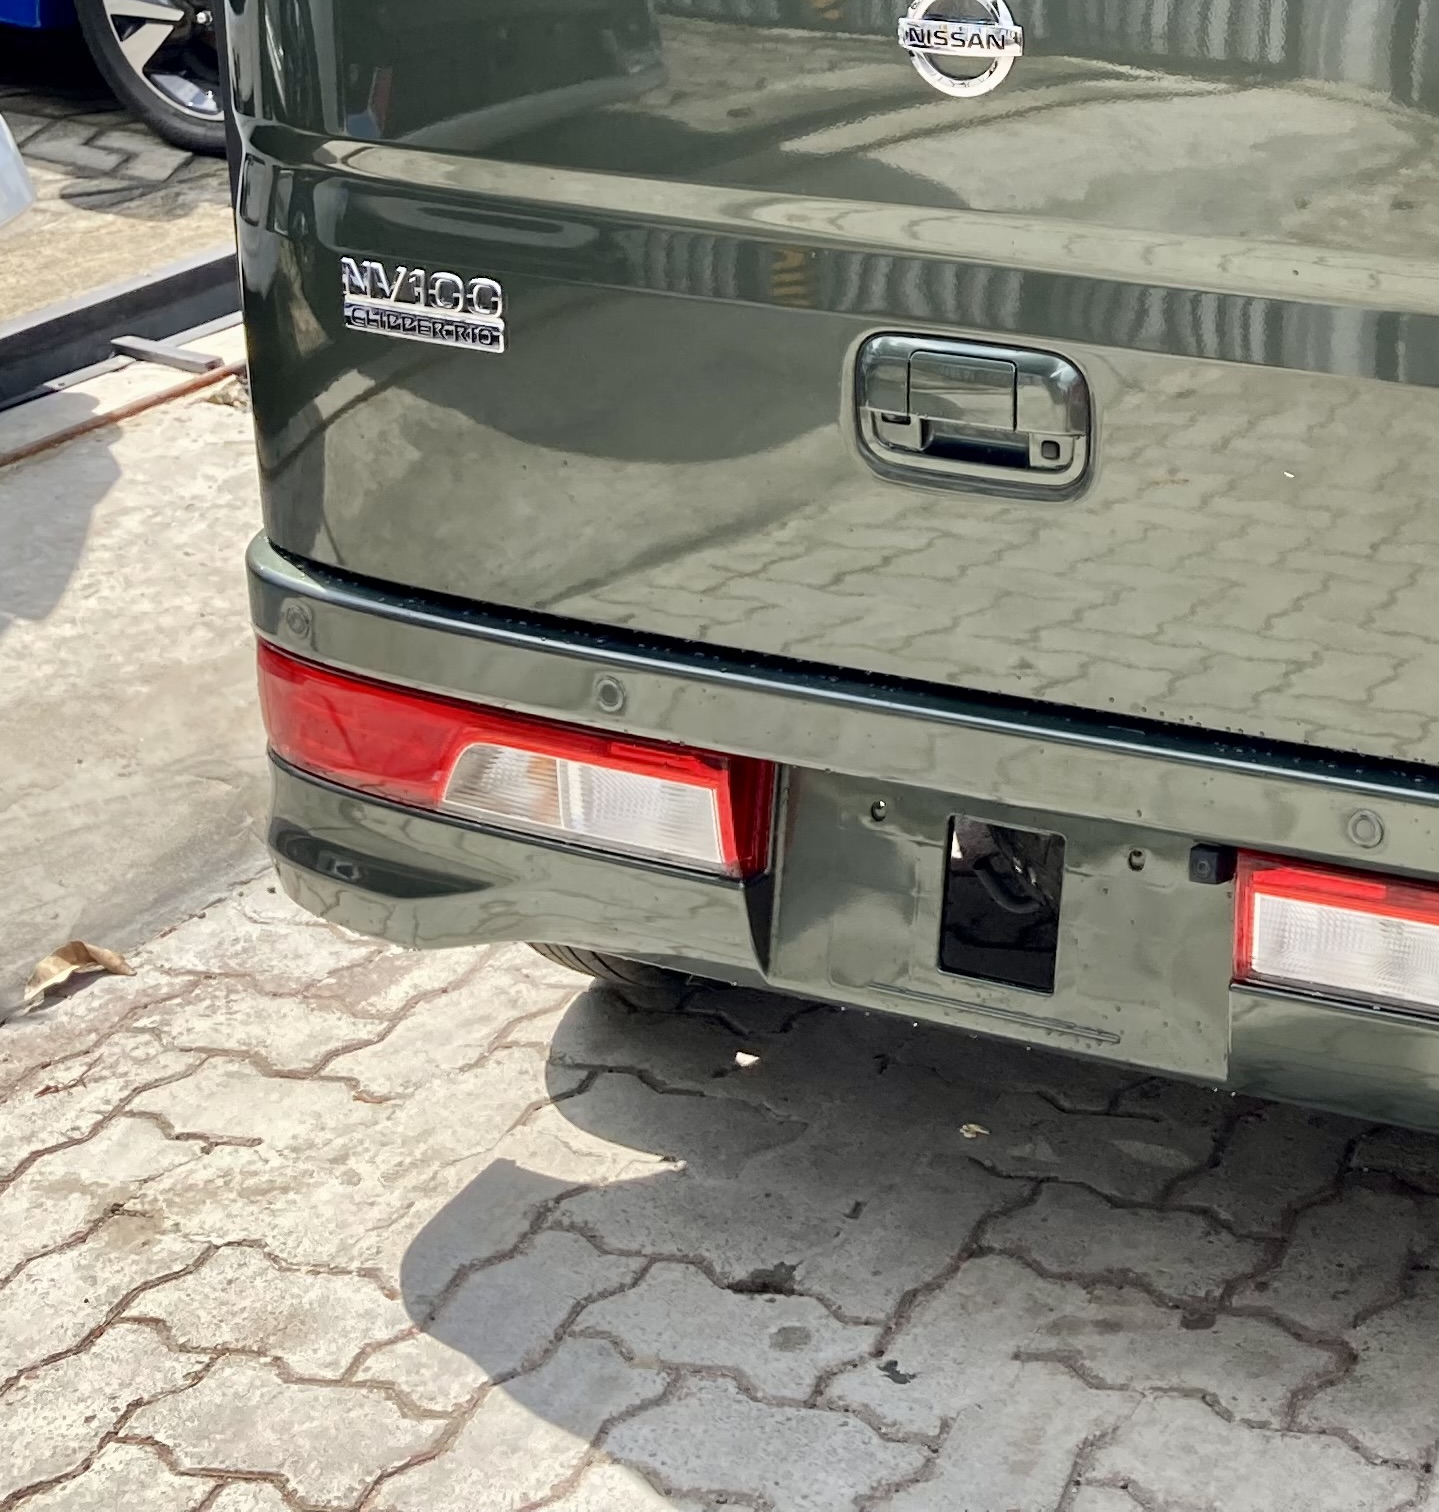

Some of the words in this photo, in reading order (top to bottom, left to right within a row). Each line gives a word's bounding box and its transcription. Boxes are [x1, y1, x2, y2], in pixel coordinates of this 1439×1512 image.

[906, 26, 1006, 51] NISSAN
[340, 255, 504, 318] NV100
[350, 306, 449, 340] CLIPPER
[453, 323, 493, 346] RIO
